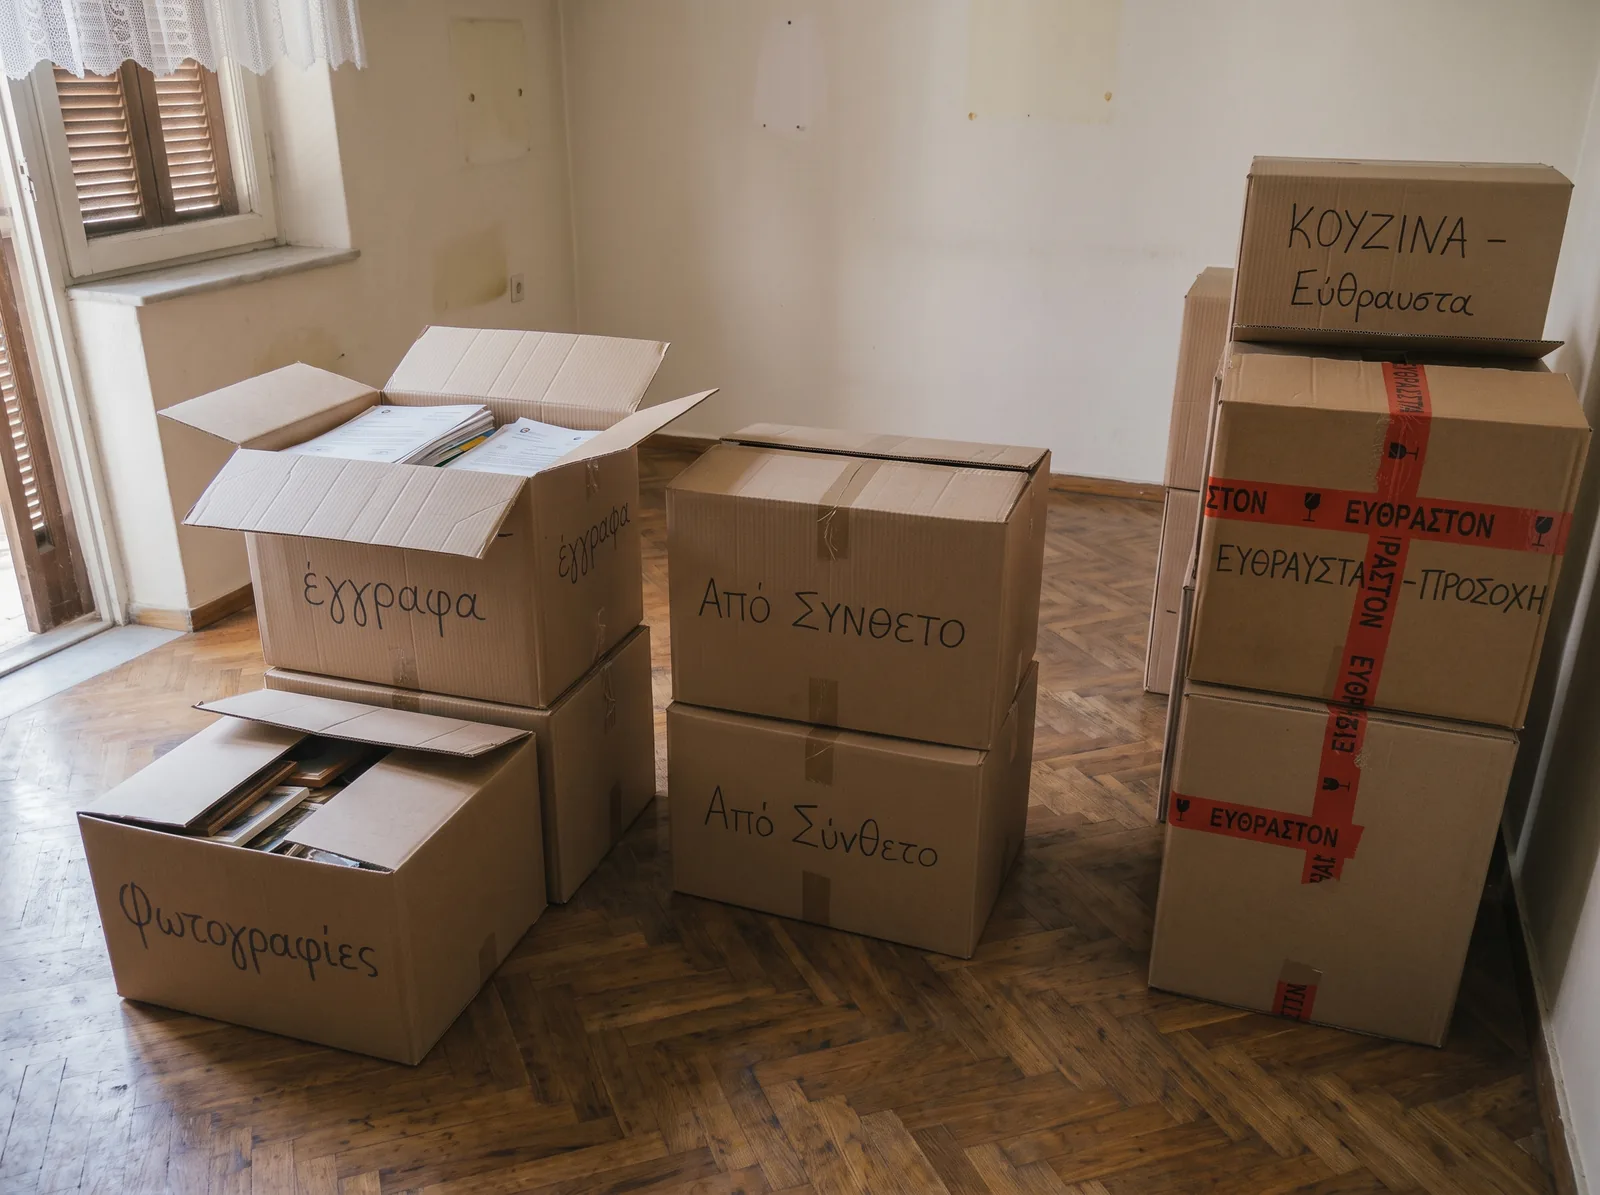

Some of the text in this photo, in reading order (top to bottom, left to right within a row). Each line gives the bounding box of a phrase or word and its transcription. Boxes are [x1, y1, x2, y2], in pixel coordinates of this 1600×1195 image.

[1288, 202, 1468, 259] ΚΟΥΖΙΝΑ
[1290, 268, 1474, 323] Εύθραυστα
[558, 502, 631, 585] έγγραφα
[1345, 499, 1496, 540] ΕΥΘΡΑΣΤΟΝ
[1216, 543, 1365, 589] ΕΥΘΡΑΥΣΤΑ
[303, 561, 486, 638] έγγραφα
[698, 577, 771, 624] Από
[704, 785, 938, 867] Από Σύνθετο
[1209, 807, 1339, 848] ΕΥΘΡΑΣΤΟΝ
